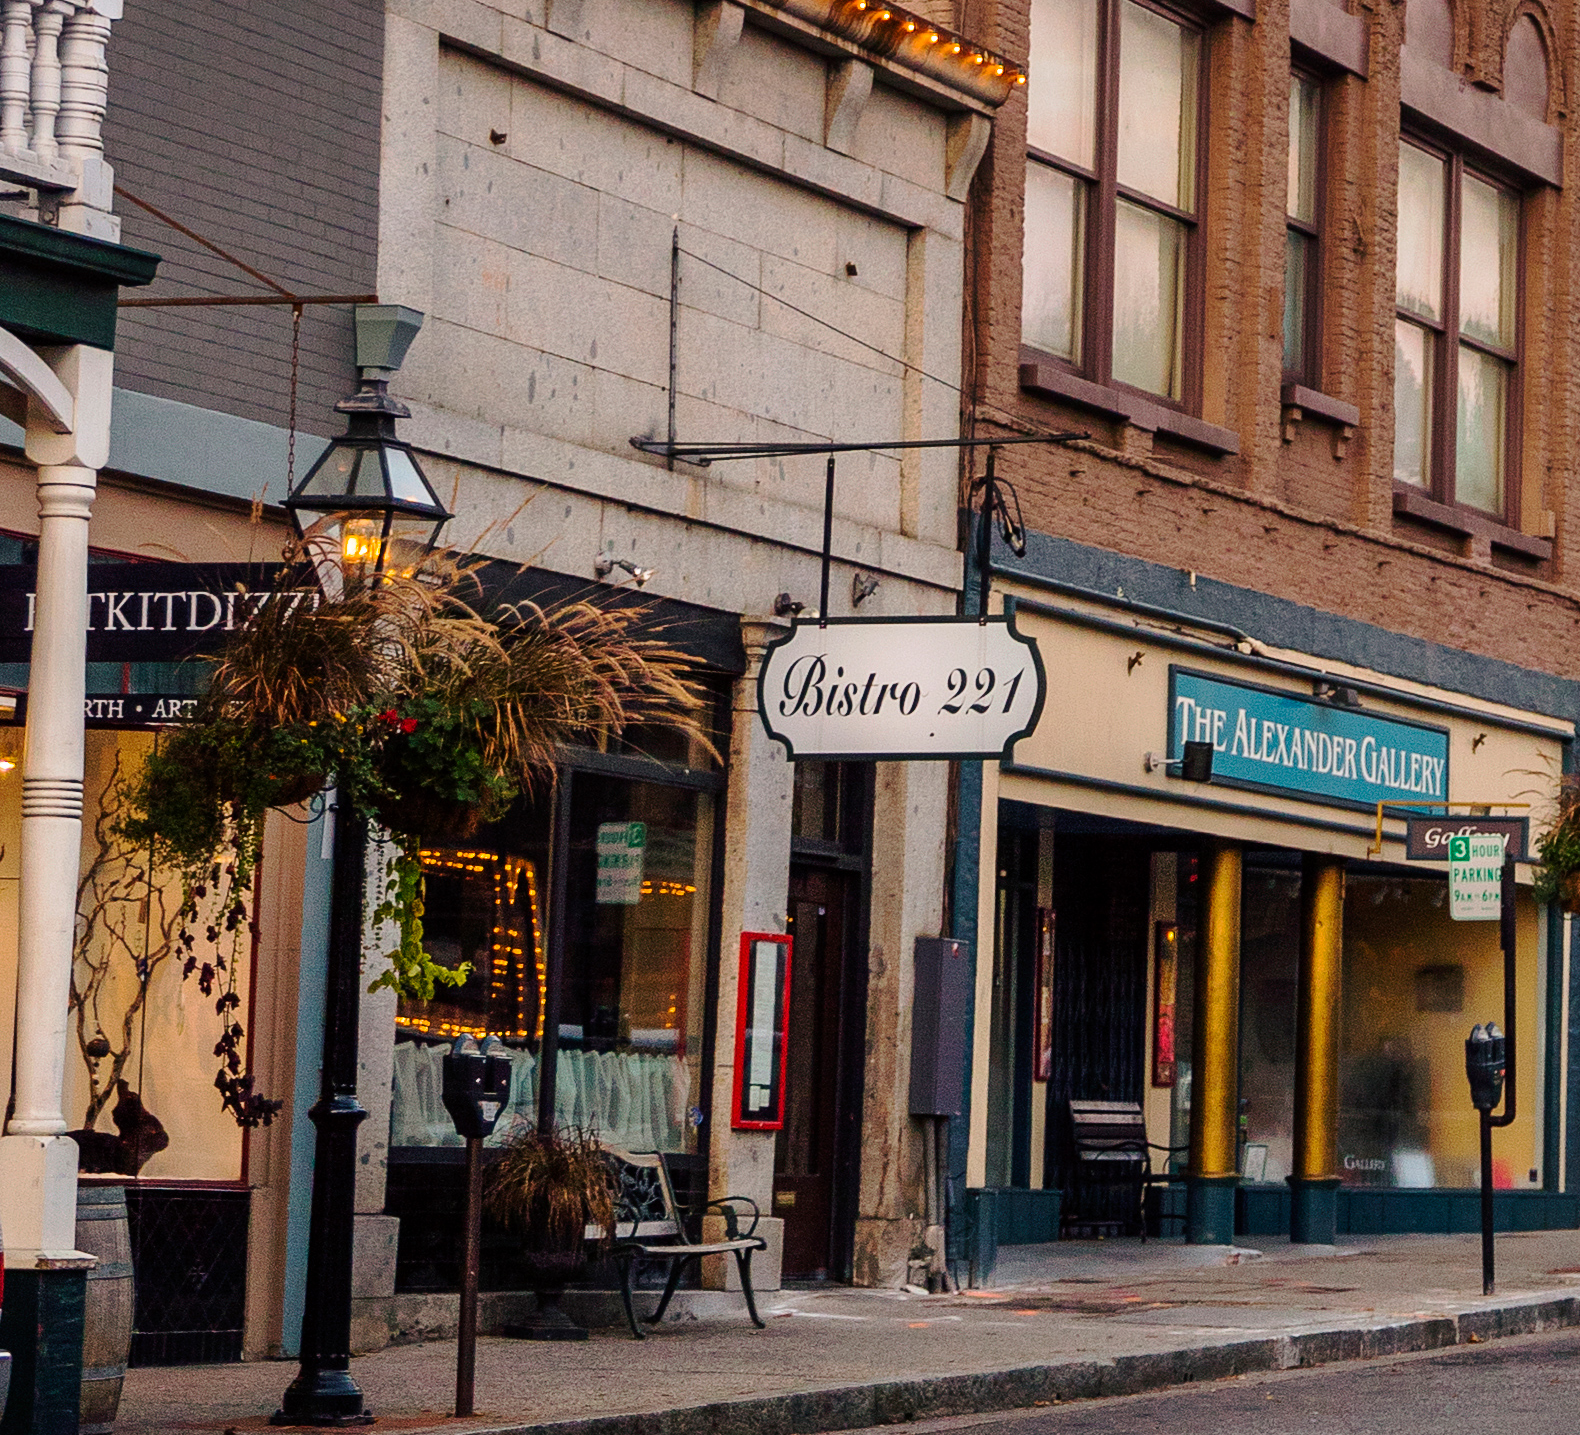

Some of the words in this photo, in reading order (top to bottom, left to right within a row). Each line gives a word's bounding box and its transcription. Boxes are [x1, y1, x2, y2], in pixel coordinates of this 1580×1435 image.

[779, 653, 929, 717] Bistro
[937, 667, 1025, 715] 221
[152, 697, 197, 718] ART
[1176, 696, 1227, 752] THE
[1231, 708, 1358, 780] ALEXANDER
[1360, 735, 1445, 796] GALLERY
[1455, 840, 1467, 857] 3
[1472, 845, 1500, 857] HOUR
[1453, 868, 1502, 882] PARKING
